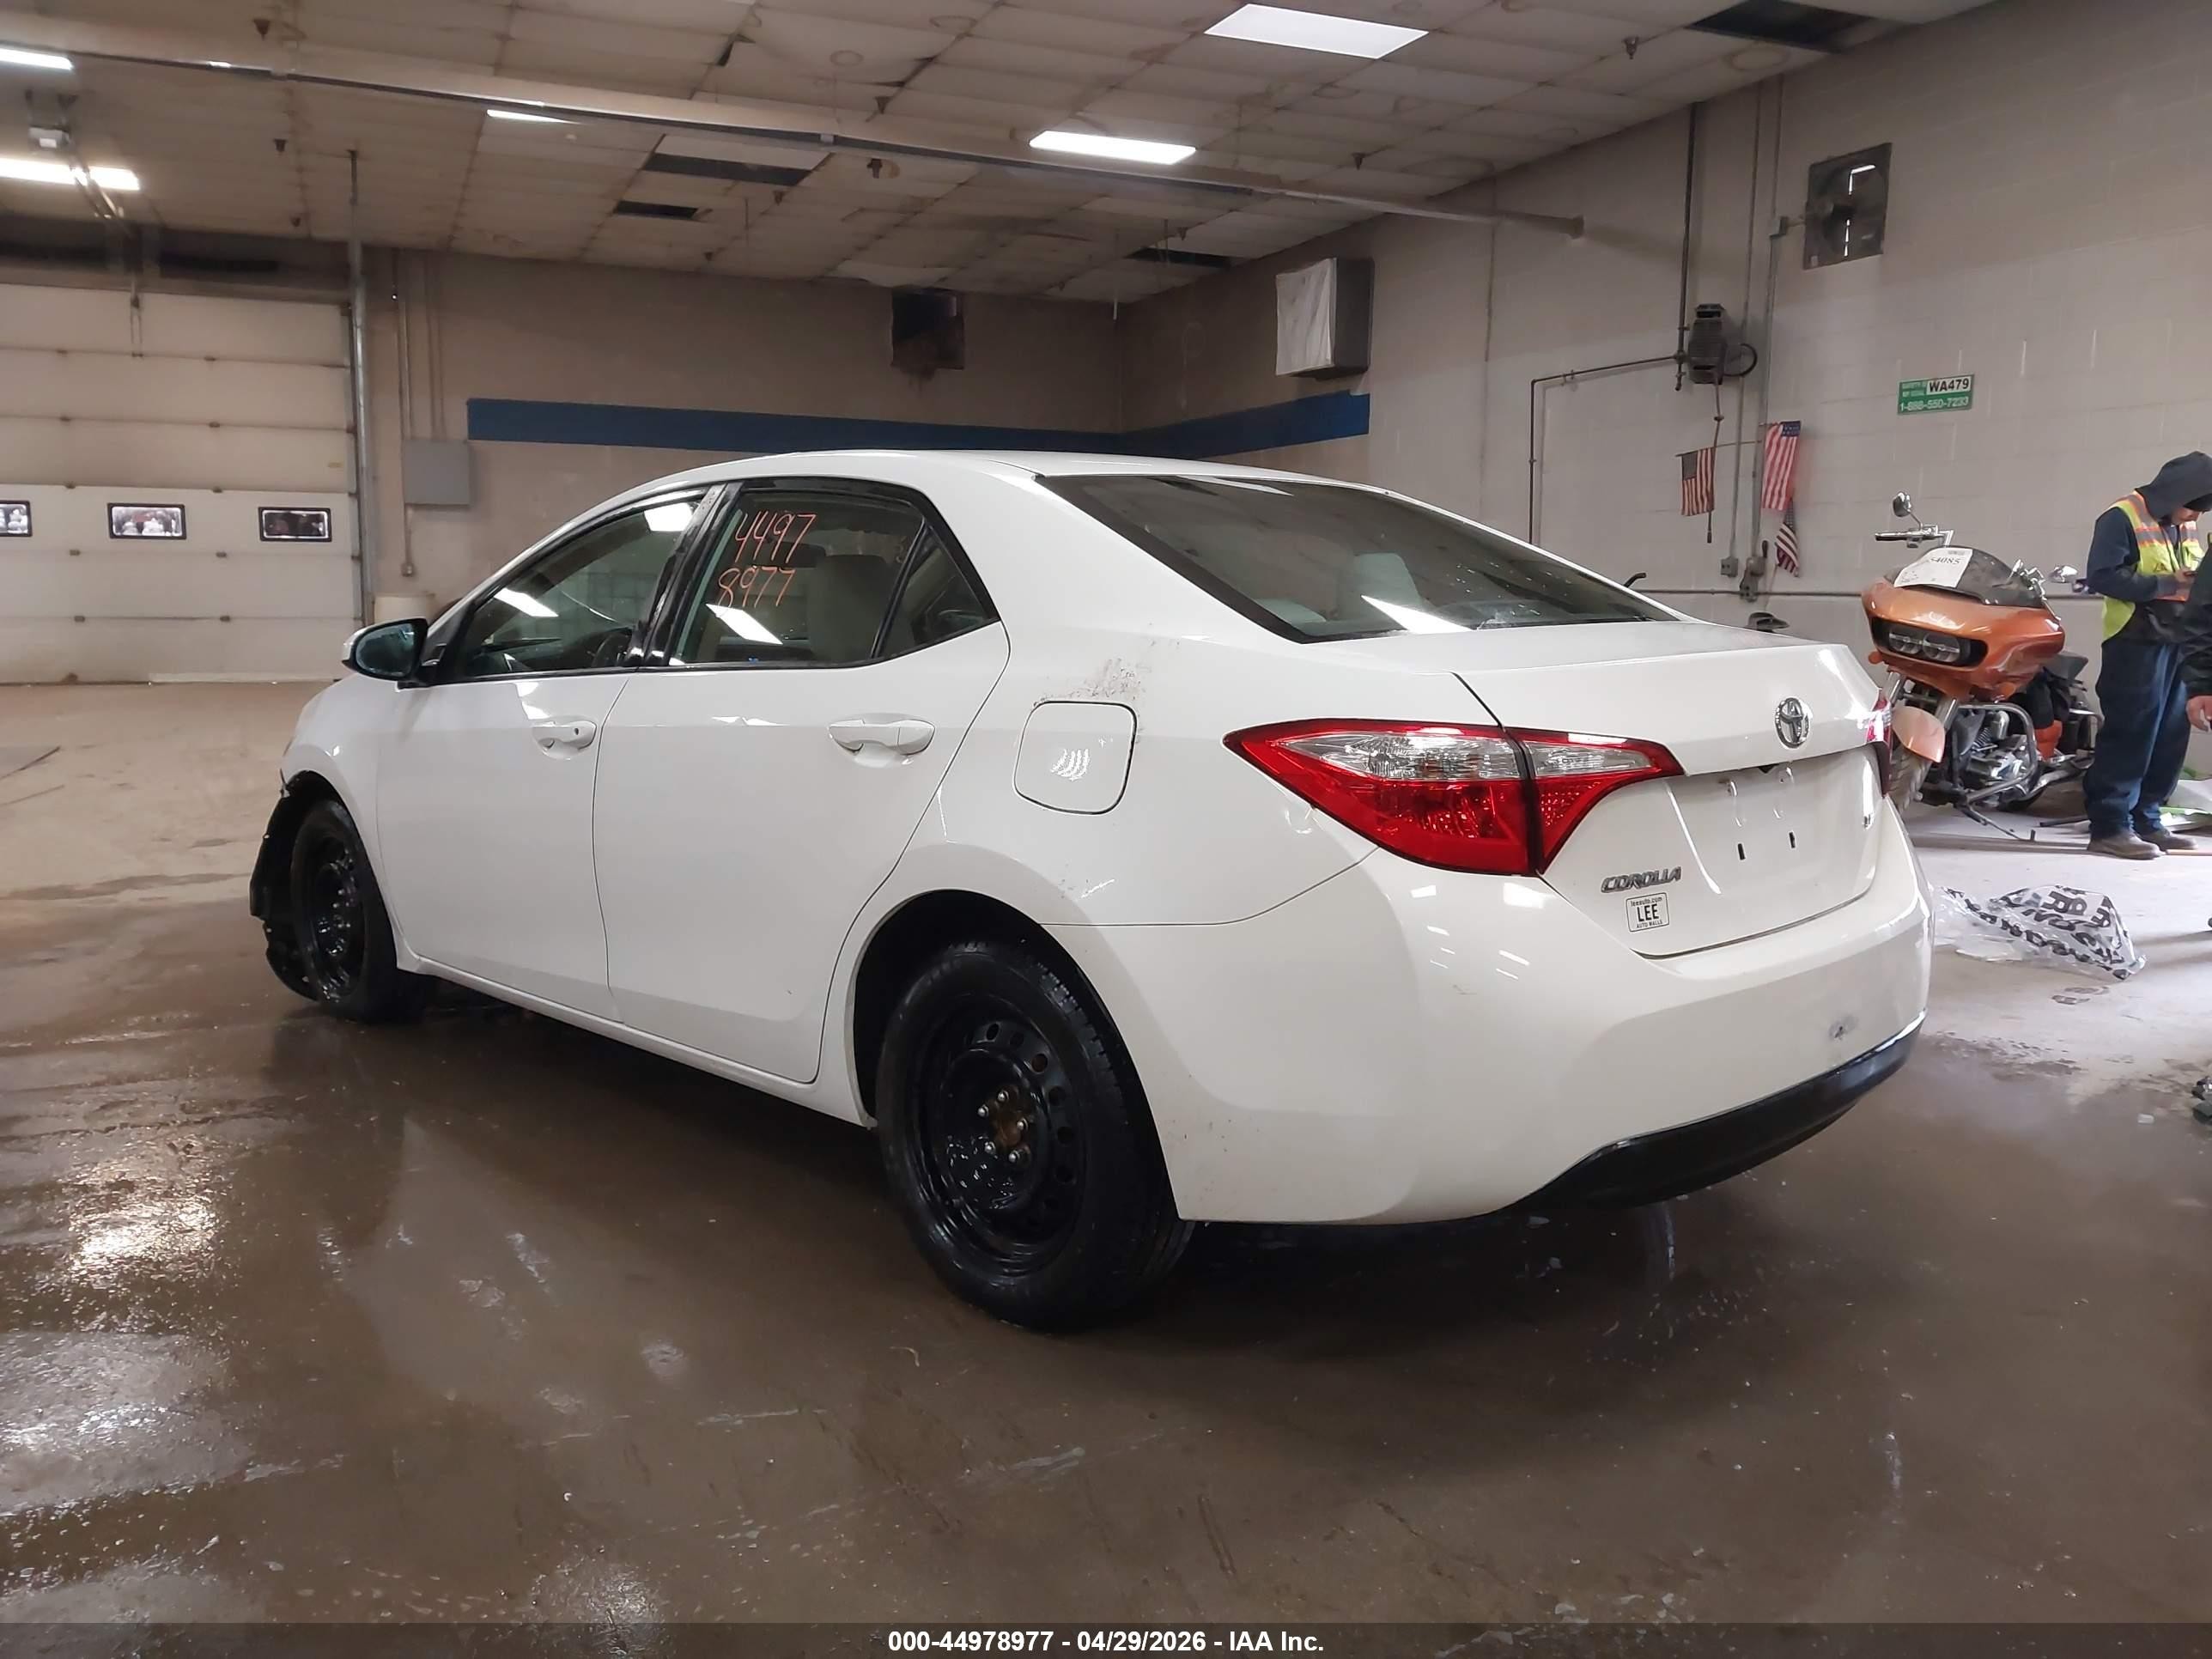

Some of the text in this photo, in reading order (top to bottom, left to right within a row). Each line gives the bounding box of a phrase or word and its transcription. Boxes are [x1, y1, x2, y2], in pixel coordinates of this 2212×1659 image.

[1929, 378, 1969, 392] WA479
[735, 509, 816, 563] 4497
[718, 565, 796, 611] 8977
[1601, 866, 1681, 893] COROLLA
[1637, 903, 1659, 921] LEE
